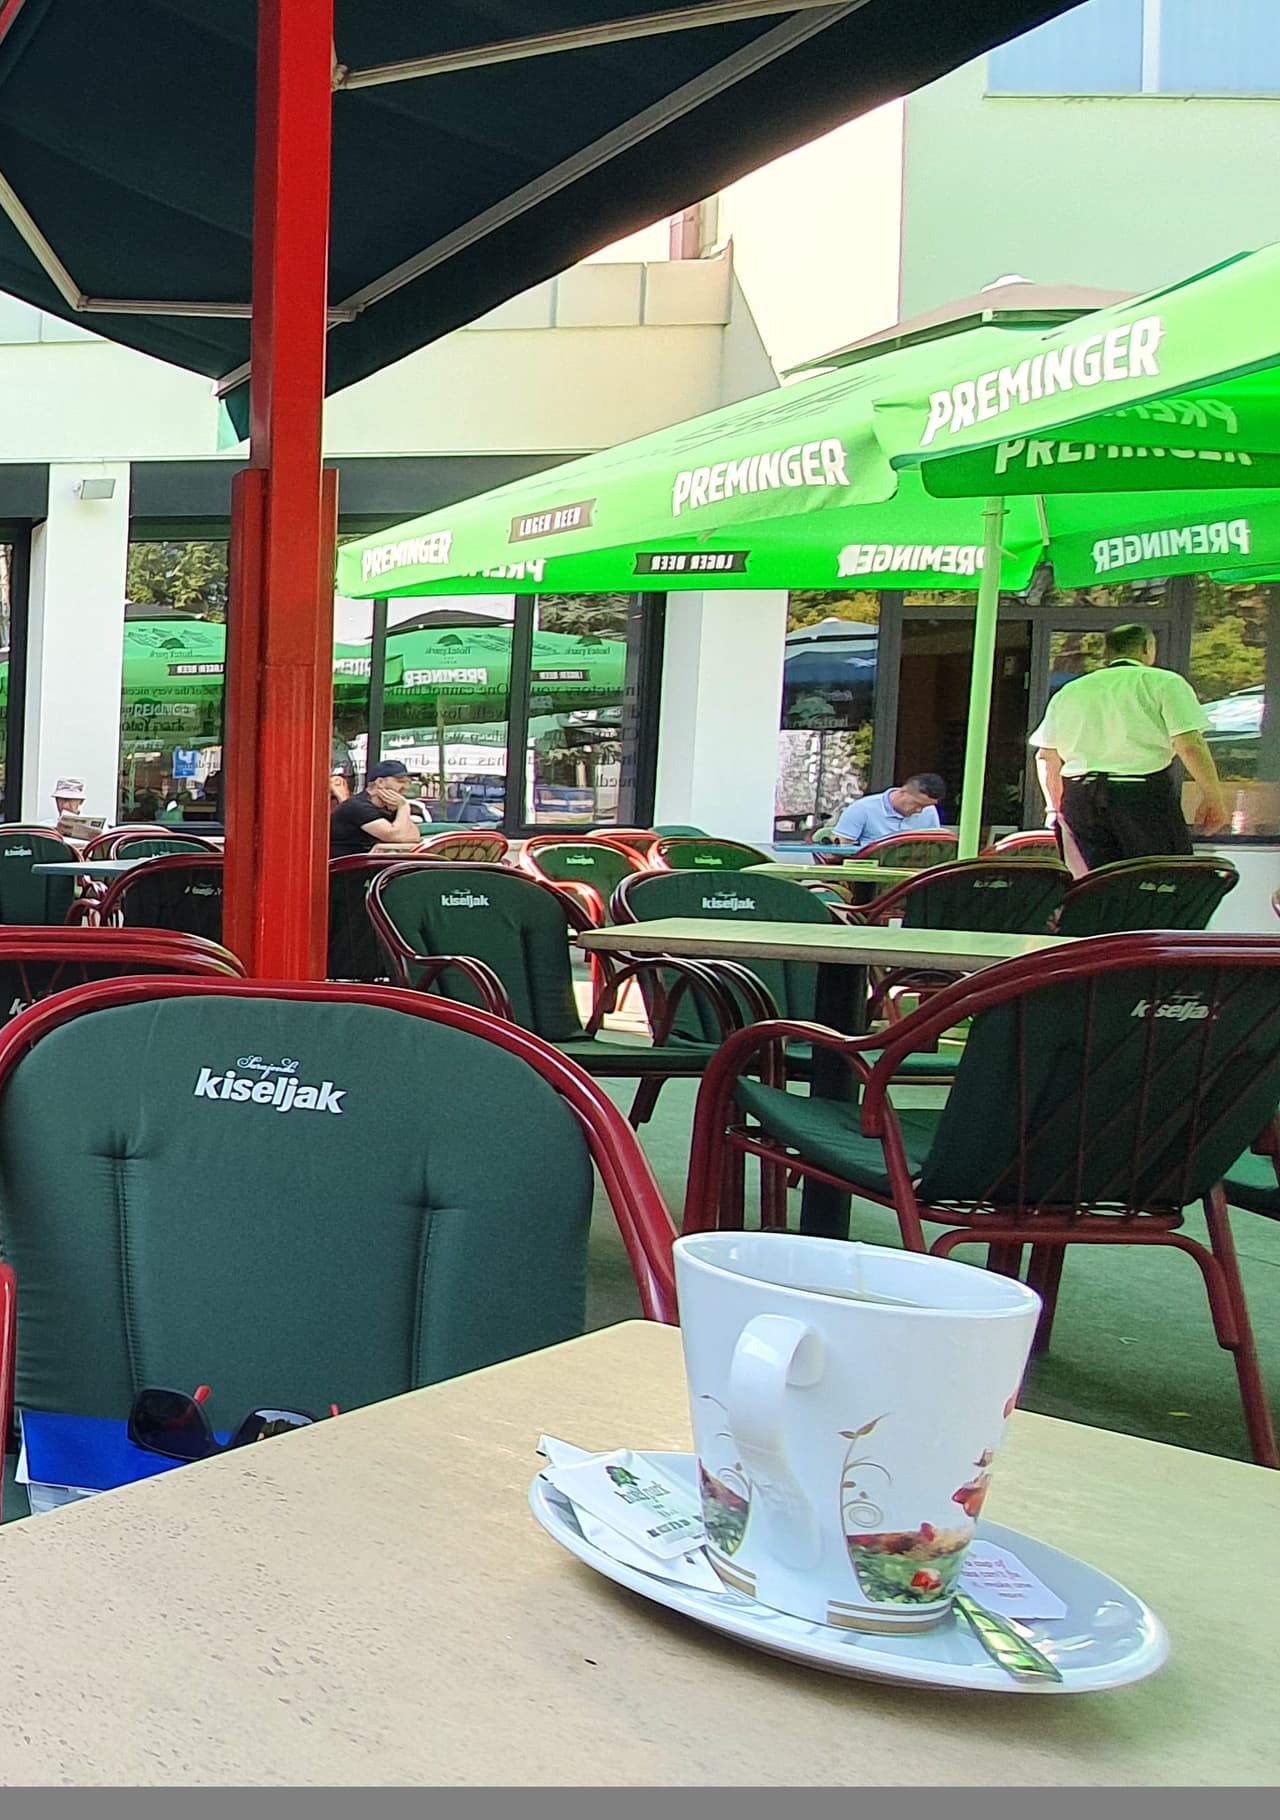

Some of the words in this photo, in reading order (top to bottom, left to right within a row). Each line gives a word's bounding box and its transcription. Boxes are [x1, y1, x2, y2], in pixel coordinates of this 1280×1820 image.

[919, 315, 1167, 447] PREMINGER
[671, 437, 850, 518] PREMINGER
[519, 513, 553, 537] LAGER
[361, 529, 453, 582] PREMINGER
[441, 892, 490, 908] kiseljak
[702, 895, 756, 911] kiseljak
[1130, 998, 1220, 1022] kselja
[194, 1067, 347, 1115] kiseljak
